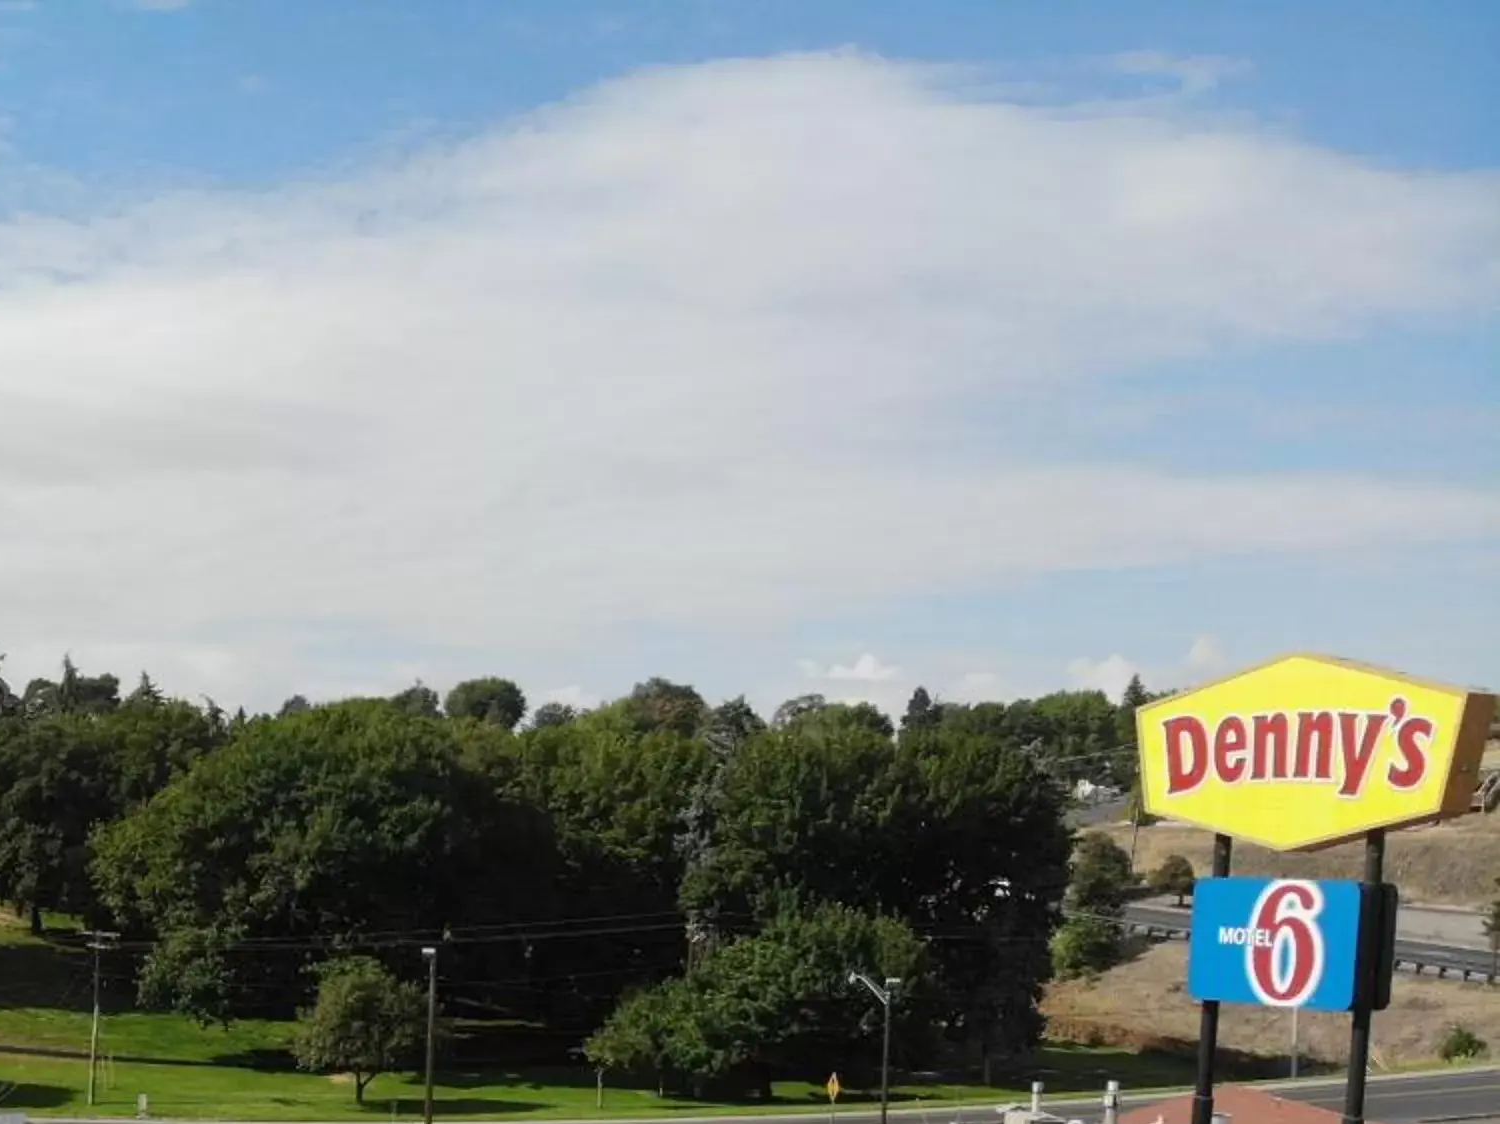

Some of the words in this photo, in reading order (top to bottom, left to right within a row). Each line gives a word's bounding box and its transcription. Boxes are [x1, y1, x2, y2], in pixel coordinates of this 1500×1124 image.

[1161, 696, 1433, 796] Denny's
[1218, 926, 1273, 947] MOTEL
[1246, 880, 1322, 1005] 6
